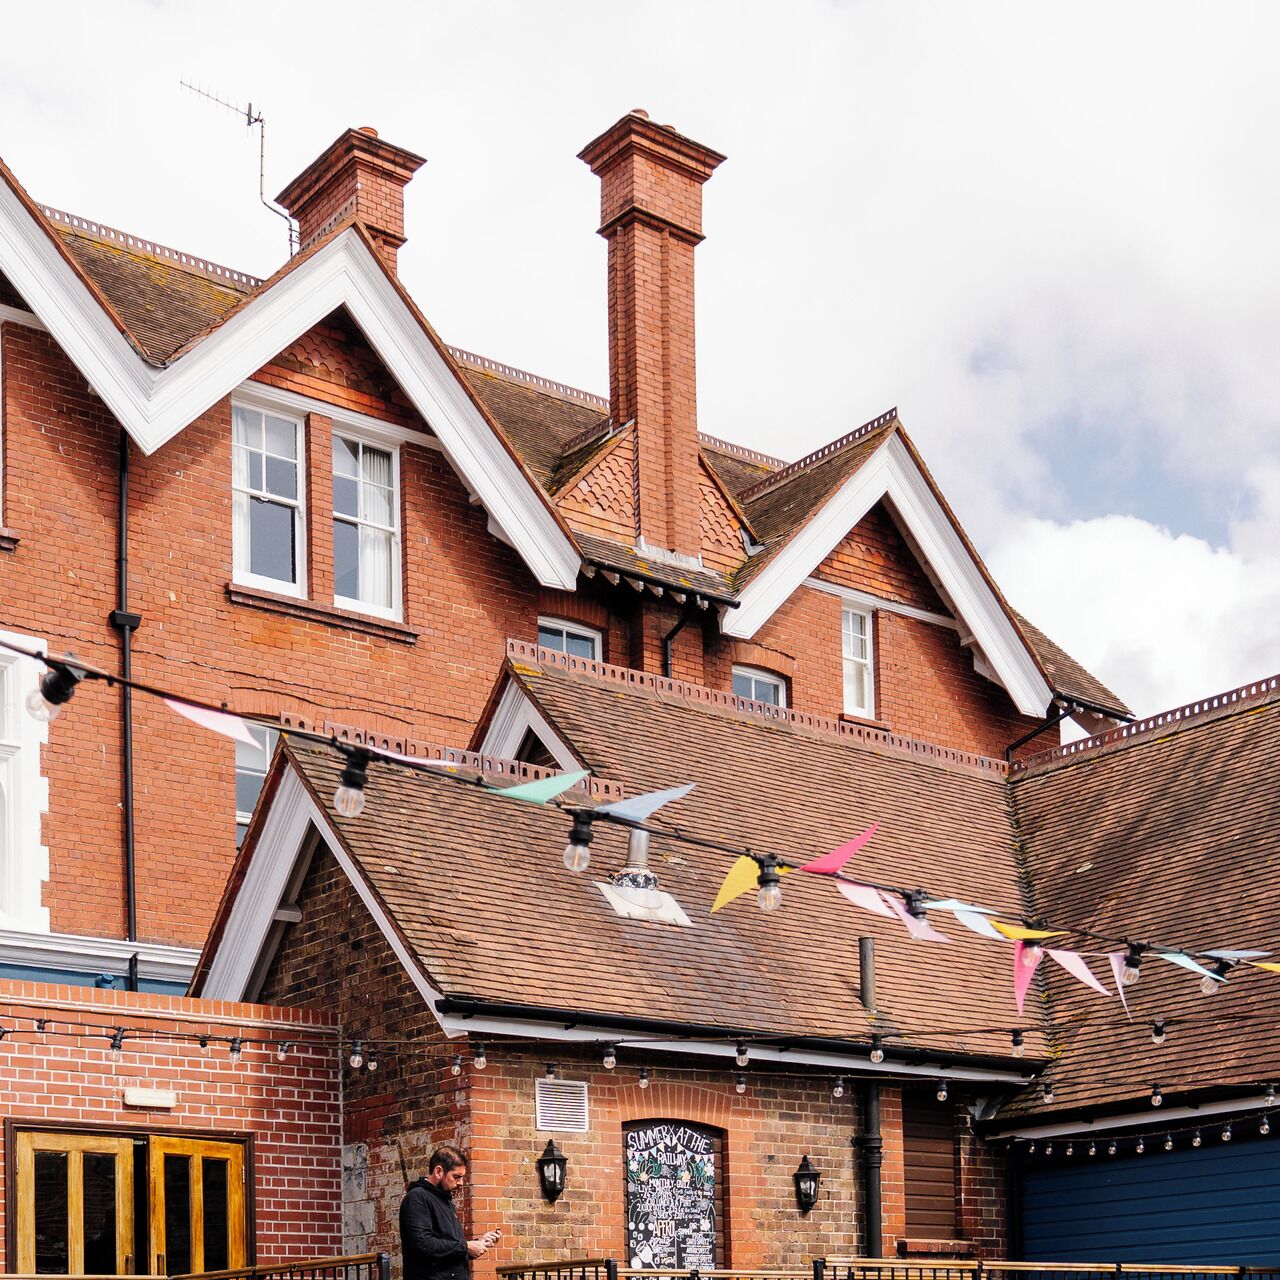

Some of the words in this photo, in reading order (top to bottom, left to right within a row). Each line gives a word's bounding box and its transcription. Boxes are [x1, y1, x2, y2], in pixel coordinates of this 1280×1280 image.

[628, 1125, 668, 1150] SUMMER
[675, 1126, 692, 1145] AT
[690, 1132, 710, 1153] THE
[657, 1152, 687, 1166] RAILWAY
[648, 1178, 674, 1188] MONTHLY
[653, 1220, 675, 1237] APEROL
